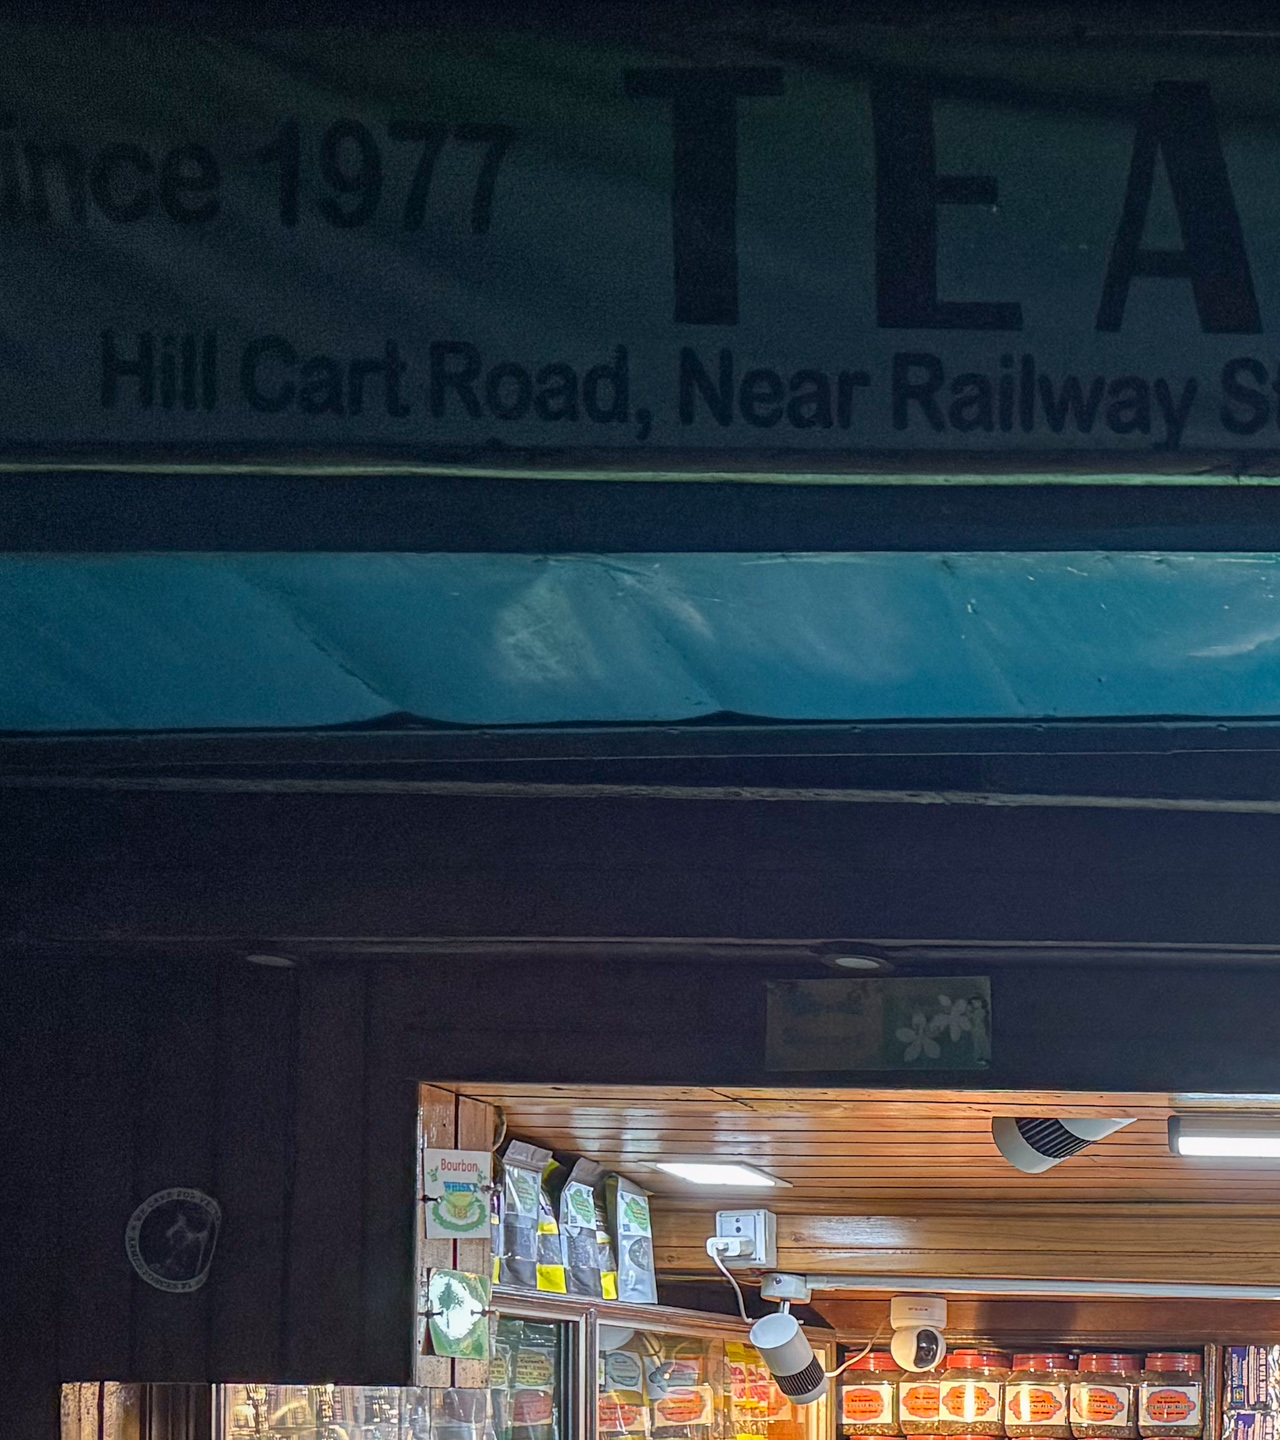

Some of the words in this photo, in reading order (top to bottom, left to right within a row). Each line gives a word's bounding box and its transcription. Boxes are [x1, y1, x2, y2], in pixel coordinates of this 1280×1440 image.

[0, 113, 222, 226] ince
[260, 118, 518, 234] 1977
[624, 66, 1263, 335] TEA
[100, 329, 219, 412] Hill
[240, 335, 412, 415] Cart
[429, 340, 651, 441] Road,
[679, 346, 870, 430] Near
[891, 351, 1197, 451] Railway
[440, 1158, 478, 1173] Bourbon
